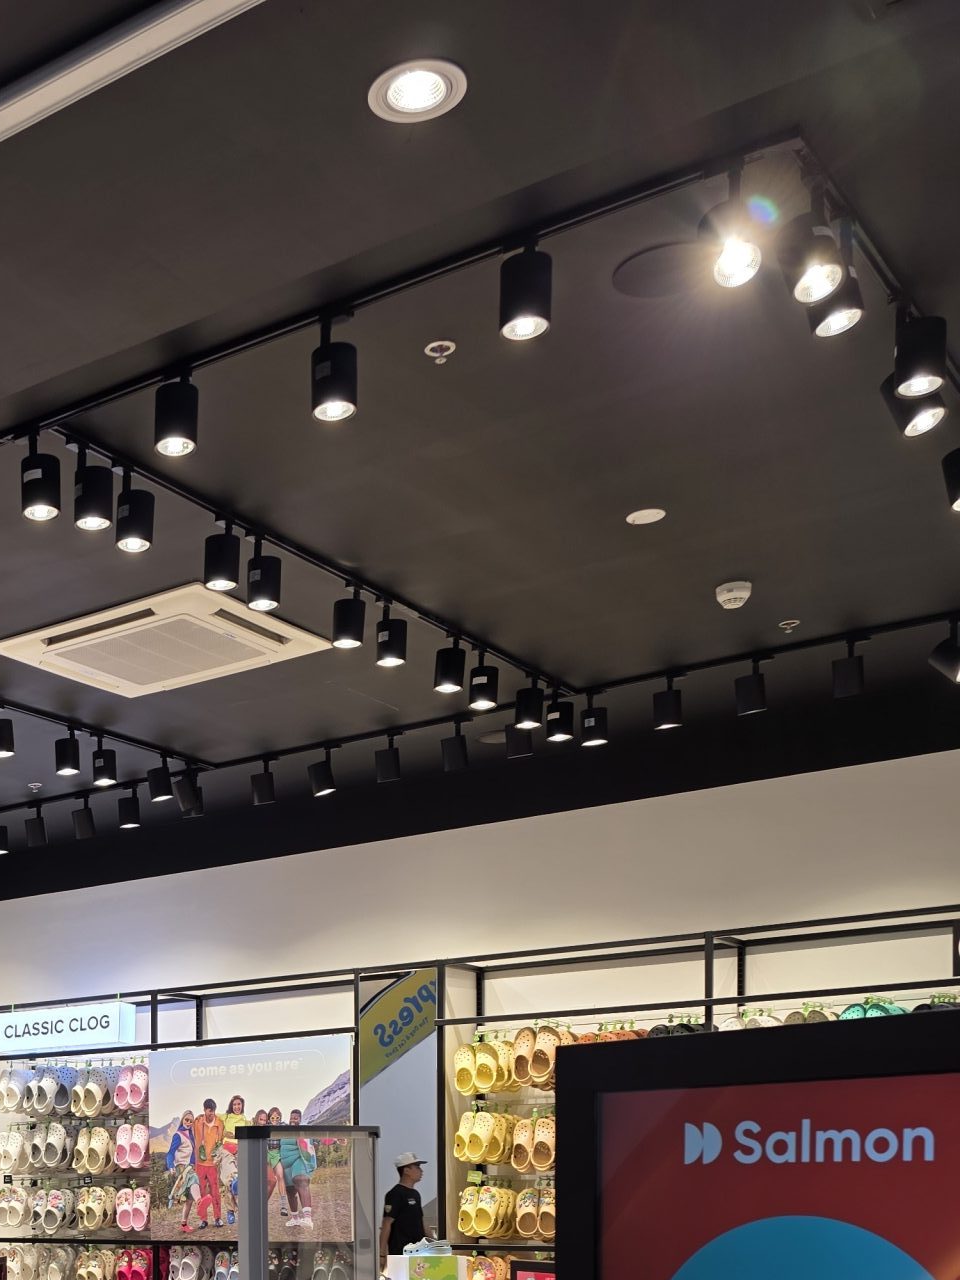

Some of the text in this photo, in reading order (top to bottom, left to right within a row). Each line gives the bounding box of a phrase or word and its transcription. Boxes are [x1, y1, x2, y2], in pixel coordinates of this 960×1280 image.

[4, 1014, 110, 1038] CLASSIC CLOG
[190, 1065, 226, 1078] come
[229, 1063, 244, 1074] as
[247, 1062, 272, 1076] you
[733, 1118, 935, 1166] Salmon
